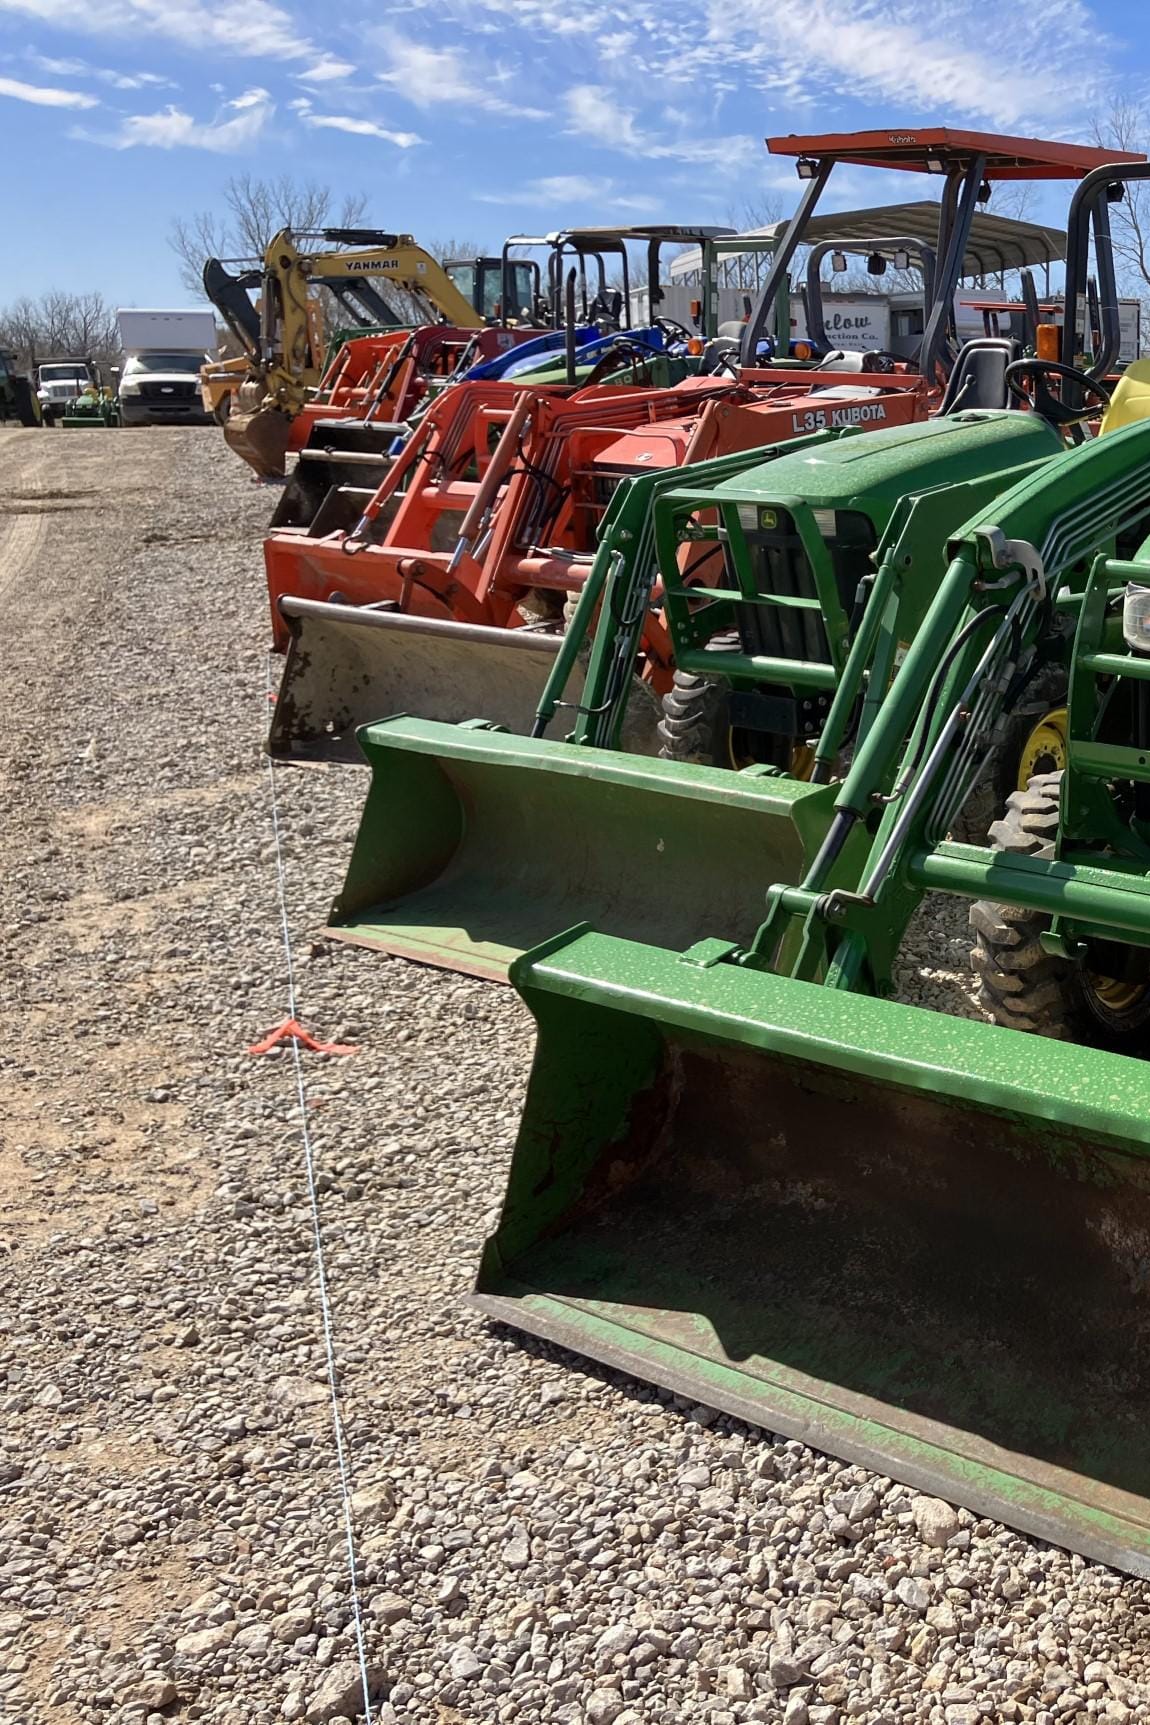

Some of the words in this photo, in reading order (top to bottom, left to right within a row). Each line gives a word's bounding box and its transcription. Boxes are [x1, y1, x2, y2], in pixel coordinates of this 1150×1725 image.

[345, 260, 399, 271] YANMAR
[792, 409, 827, 433] L35
[831, 404, 887, 427] KUBOTA
